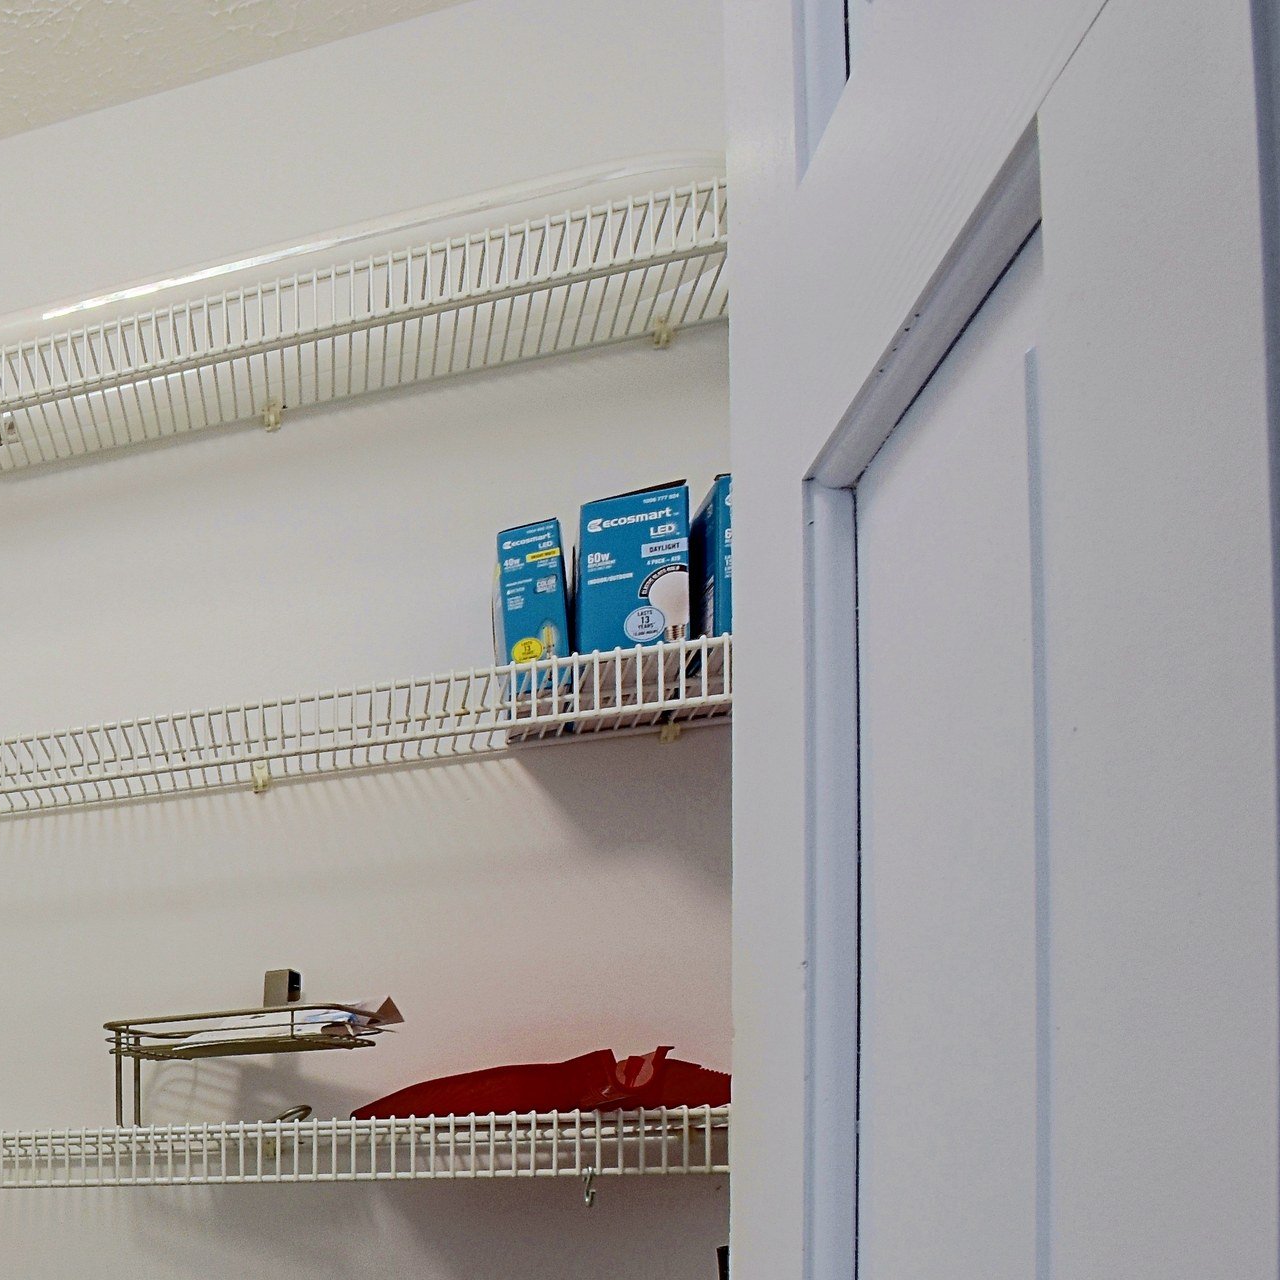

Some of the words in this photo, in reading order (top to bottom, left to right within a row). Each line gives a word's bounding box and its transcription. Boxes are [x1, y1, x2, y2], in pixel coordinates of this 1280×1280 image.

[602, 507, 672, 529] ecosmart
[650, 524, 676, 537] LED
[649, 542, 680, 553] DAYLIGHT
[640, 616, 650, 624] 13
